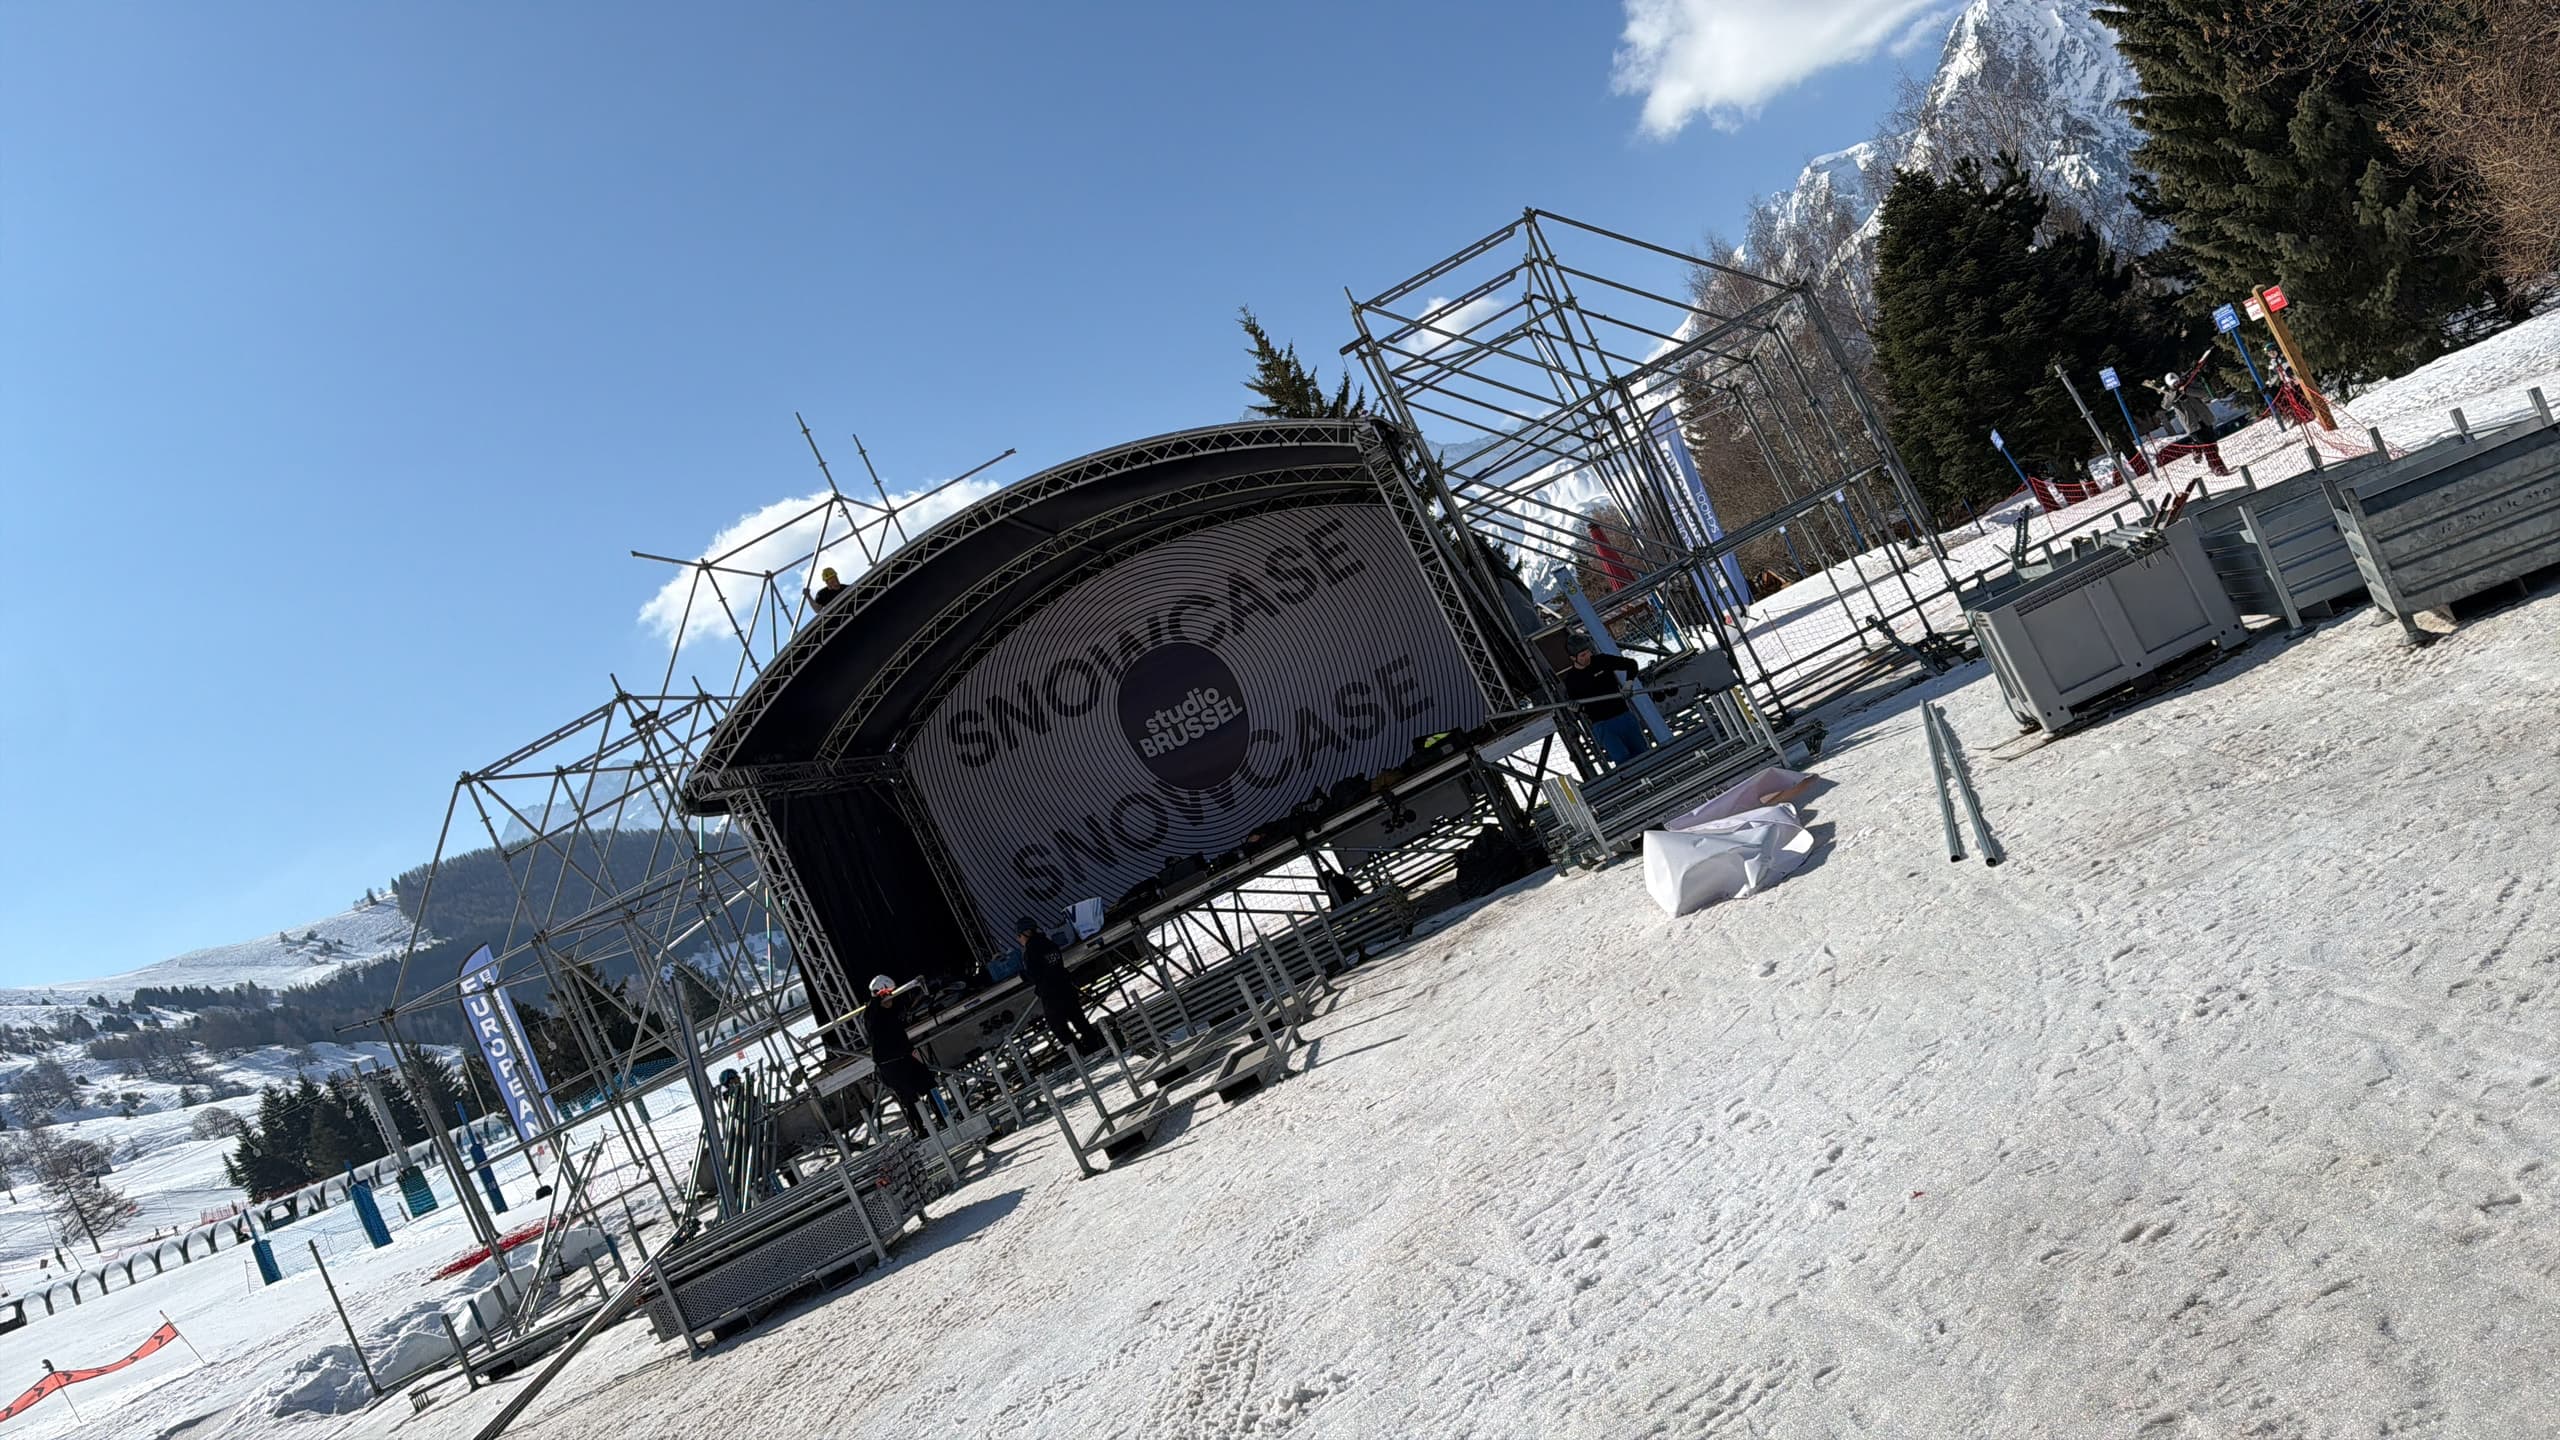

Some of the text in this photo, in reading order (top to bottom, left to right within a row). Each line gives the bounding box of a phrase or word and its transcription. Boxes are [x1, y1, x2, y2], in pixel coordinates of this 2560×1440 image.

[1695, 489, 1719, 534] SCHOOL
[950, 518, 1367, 768] SNOWCASE
[1139, 695, 1244, 759] BRUSSEL
[1144, 687, 1220, 735] studio
[1012, 653, 1435, 900] SNOWCASE
[459, 976, 540, 1137] EUROPEAN
